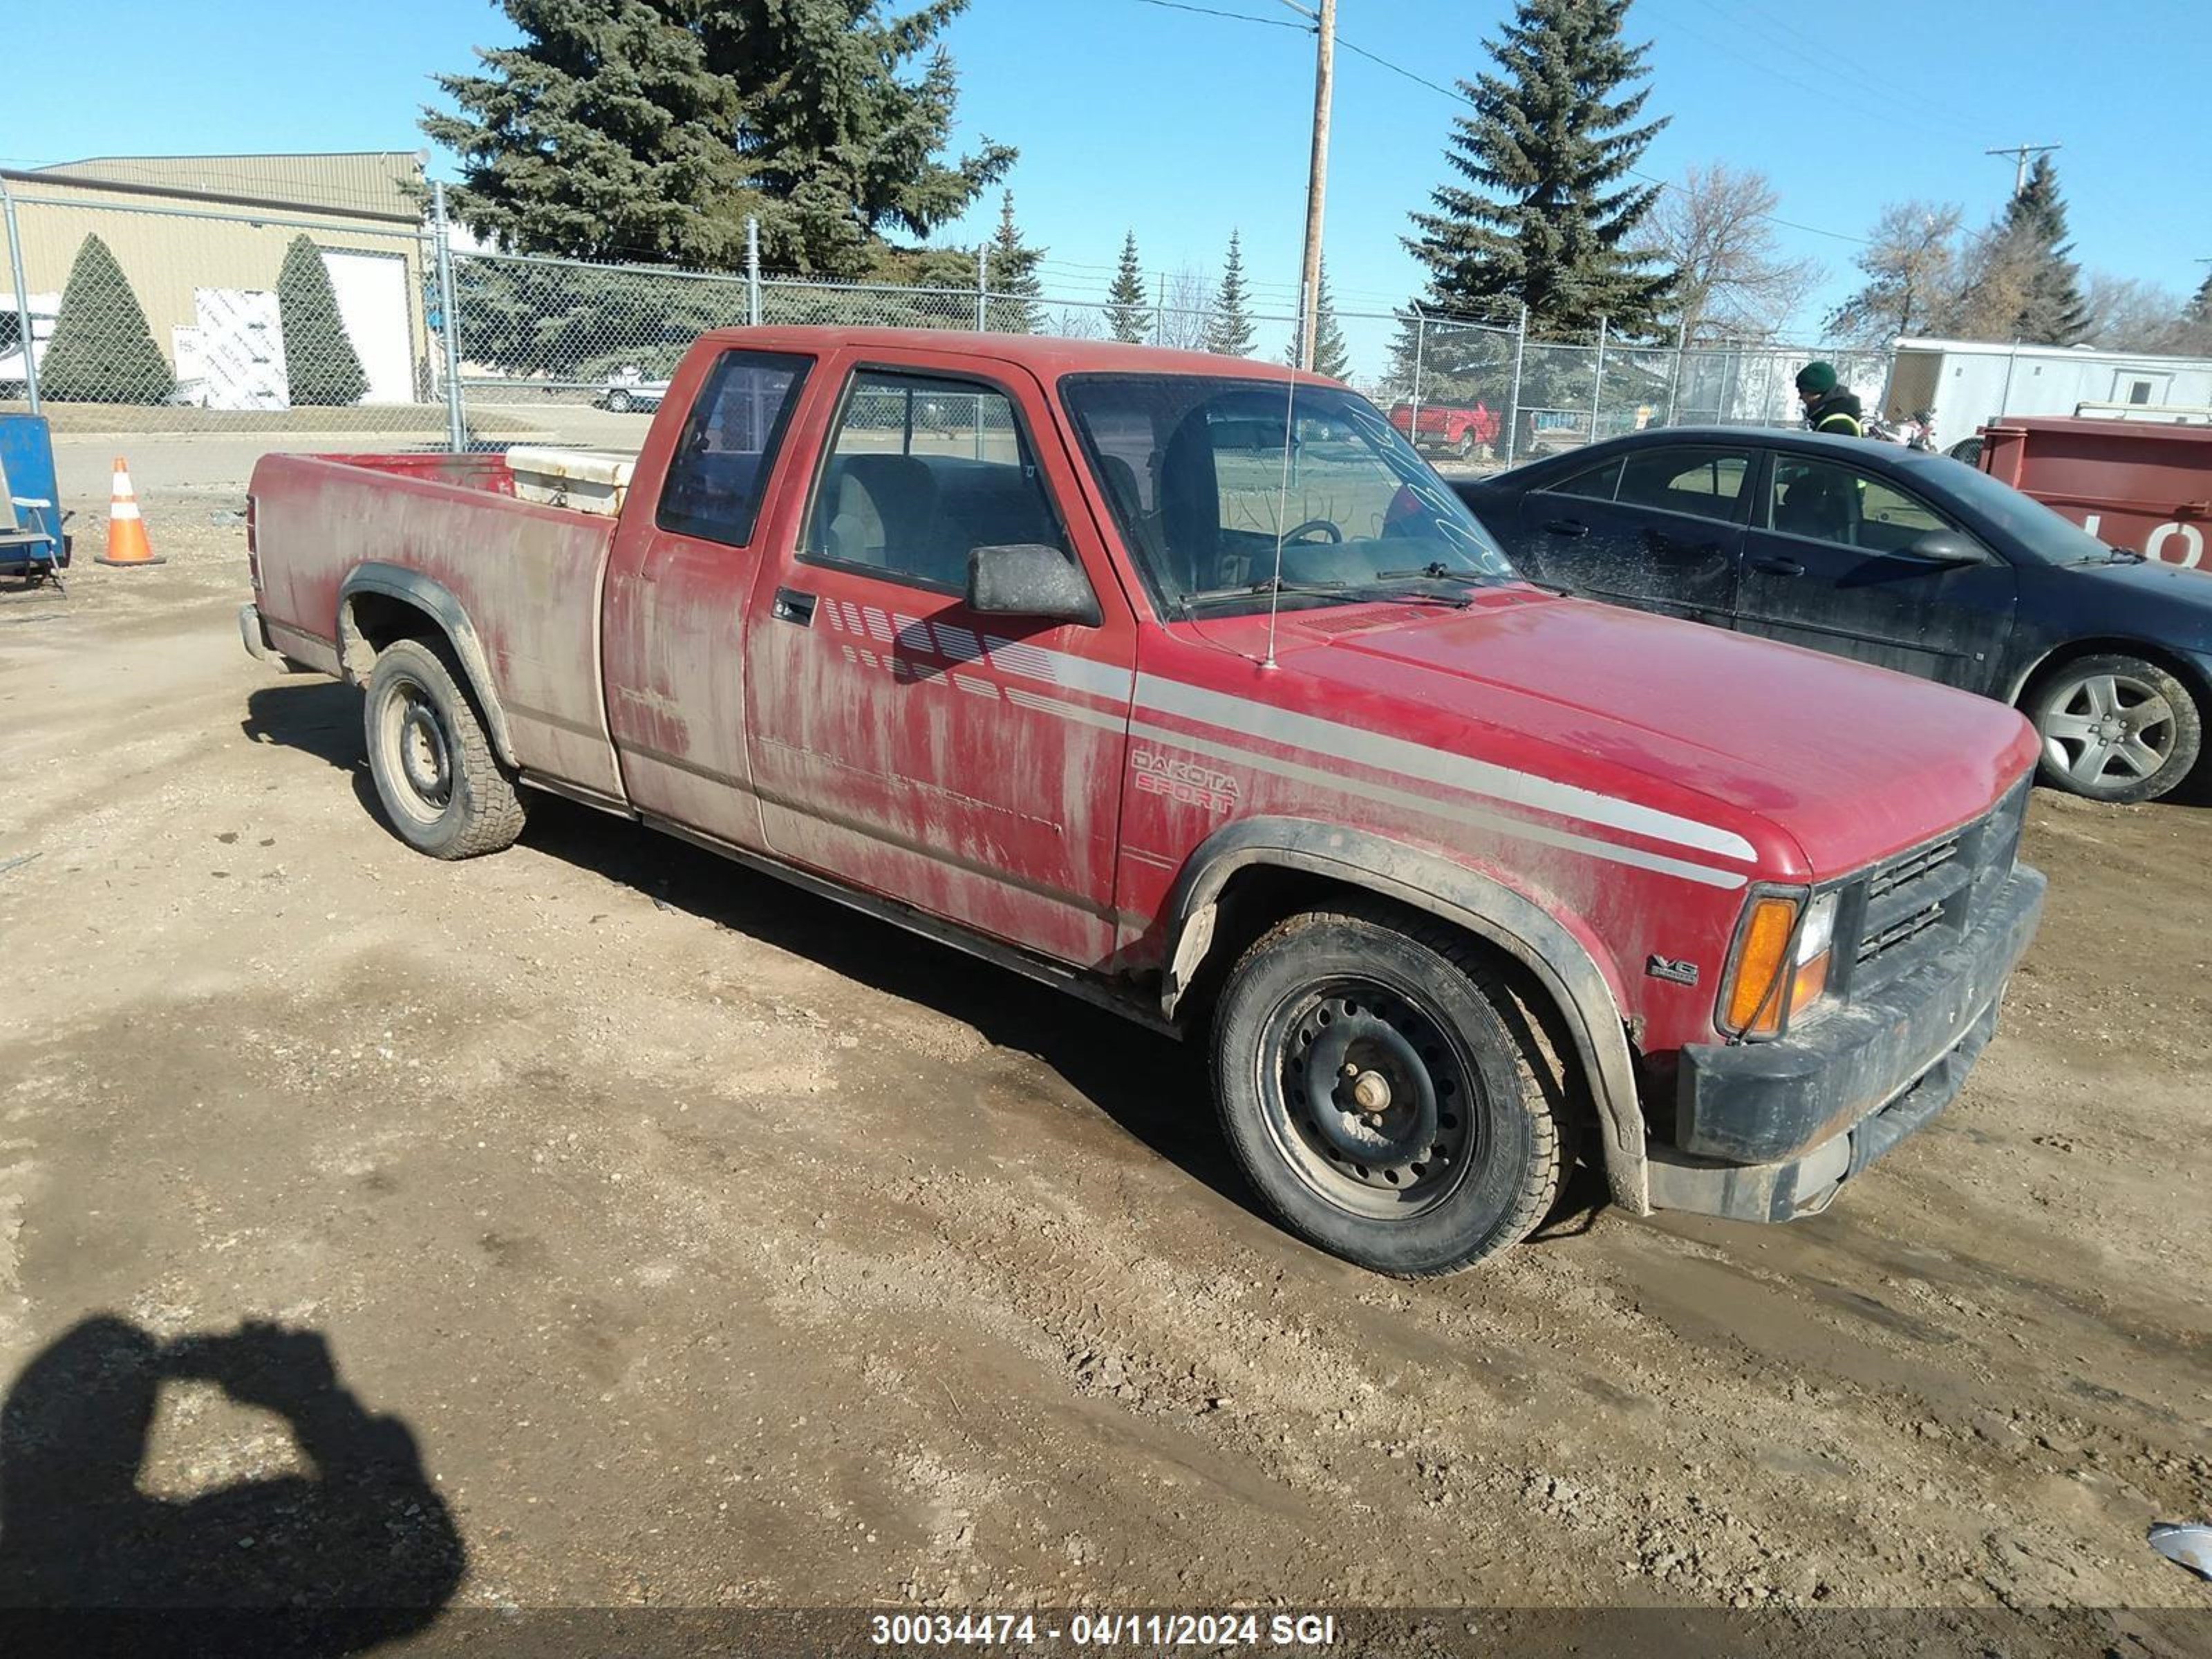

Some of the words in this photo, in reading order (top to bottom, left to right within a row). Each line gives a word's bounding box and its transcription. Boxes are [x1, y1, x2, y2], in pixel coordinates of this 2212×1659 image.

[1131, 749, 1240, 797] DAKOTA
[1135, 771, 1235, 814] SPORT
[1651, 953, 1698, 975] V6
